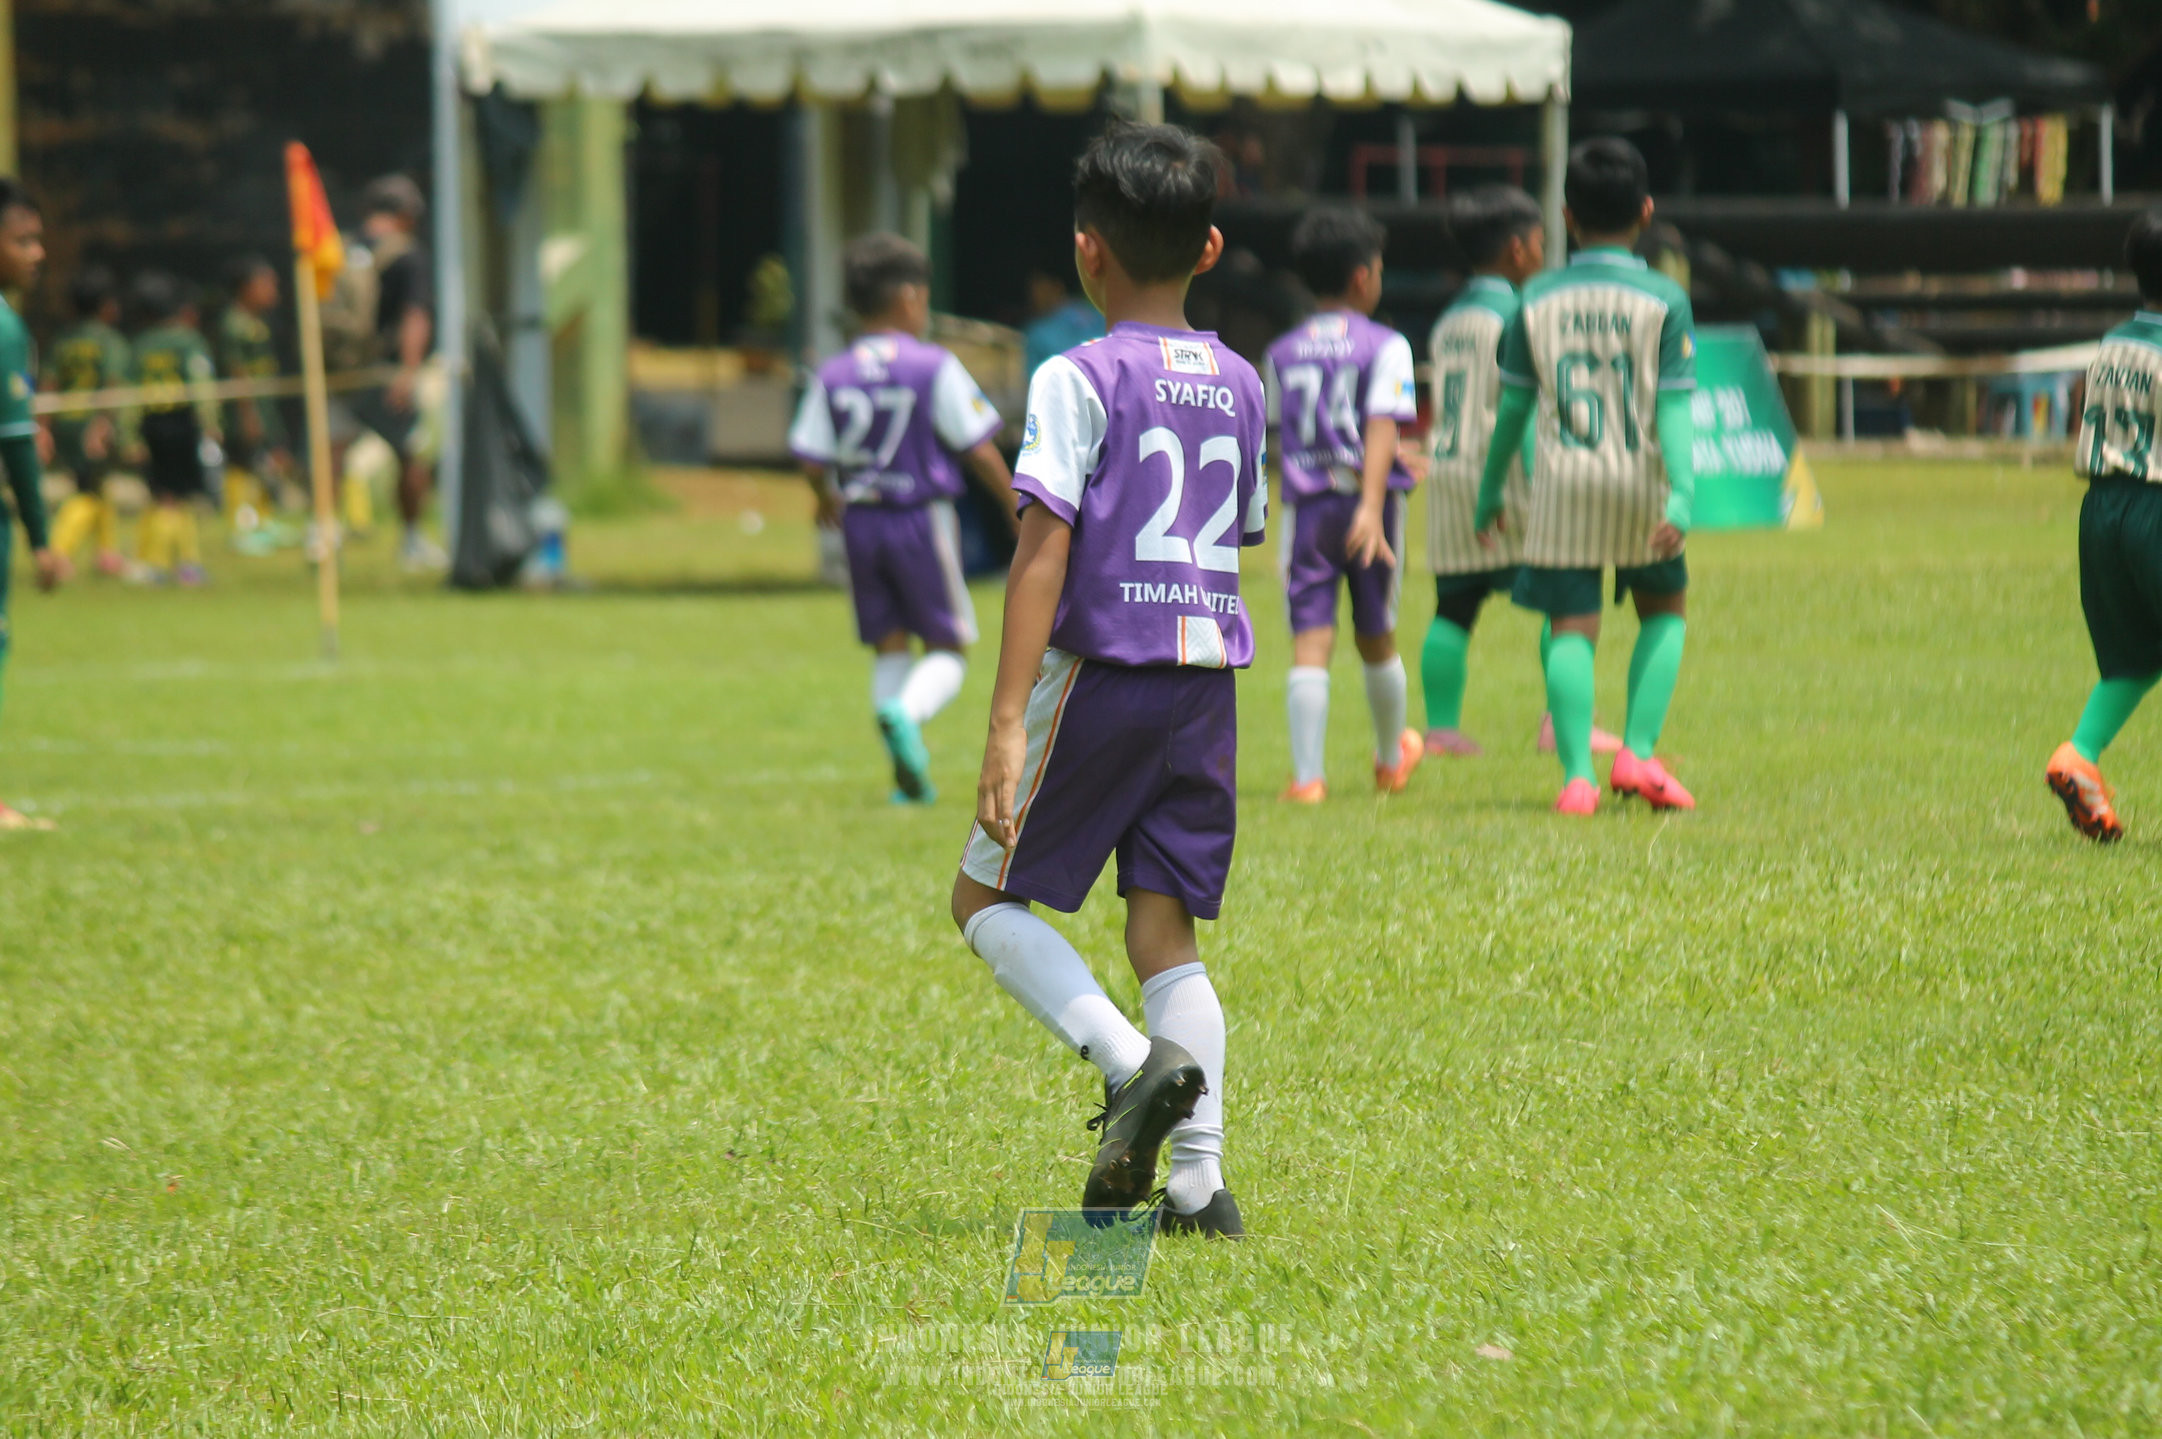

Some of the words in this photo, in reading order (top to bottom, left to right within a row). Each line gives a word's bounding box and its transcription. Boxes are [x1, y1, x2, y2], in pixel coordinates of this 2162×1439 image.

[833, 385, 918, 468] 27
[1155, 378, 1236, 417] SYAFIQ
[1556, 351, 1640, 451] 61
[1135, 425, 1242, 574] 22
[1119, 582, 1199, 605] TIMAH
